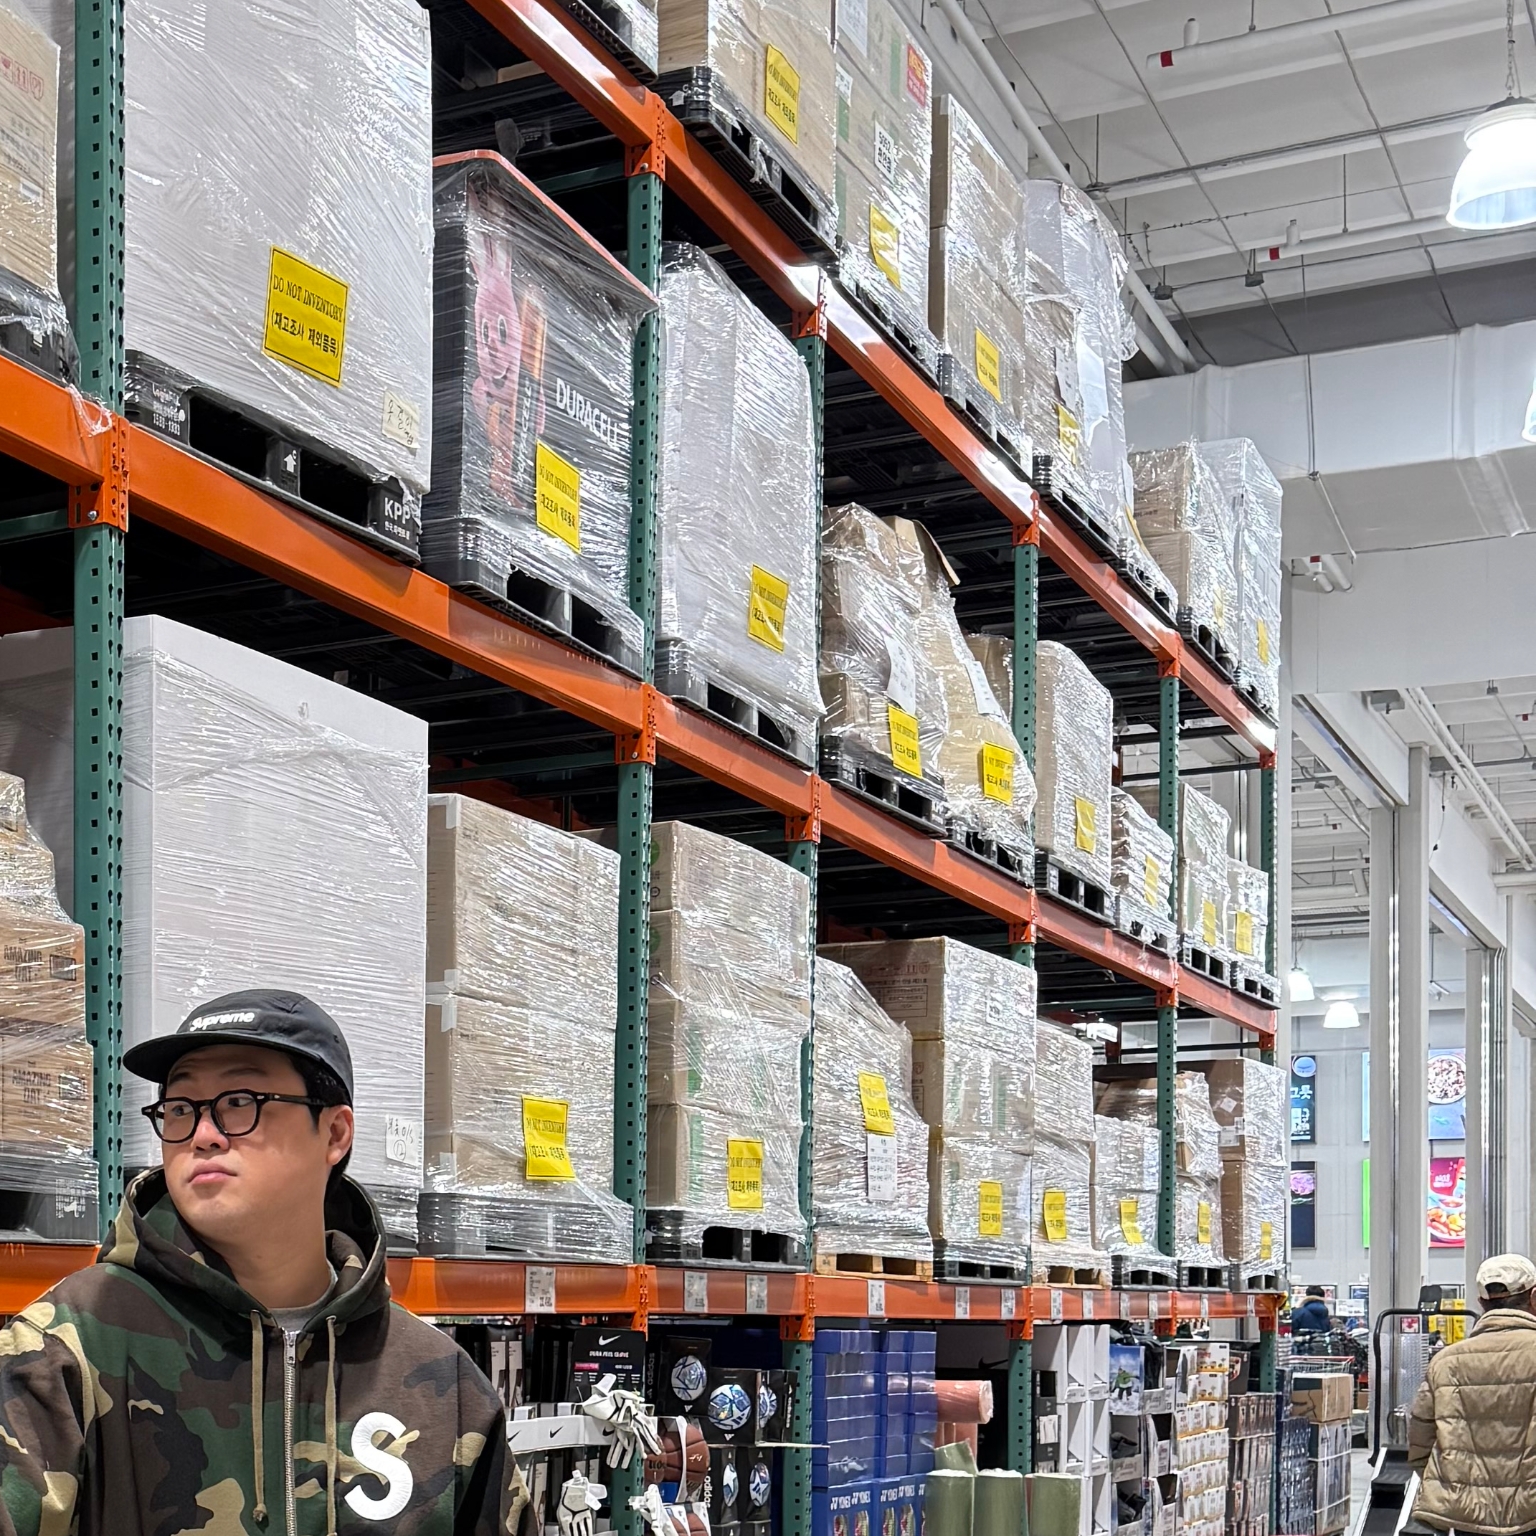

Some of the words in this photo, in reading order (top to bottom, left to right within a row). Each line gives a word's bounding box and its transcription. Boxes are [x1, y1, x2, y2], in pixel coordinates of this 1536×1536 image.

[273, 275, 284, 292] DO
[286, 281, 302, 301] NOT
[303, 288, 343, 322] INVENTORY
[384, 497, 412, 524] KPP
[189, 1012, 255, 1031] Supreme
[647, 1352, 655, 1386] adidas
[344, 1412, 413, 1520] S
